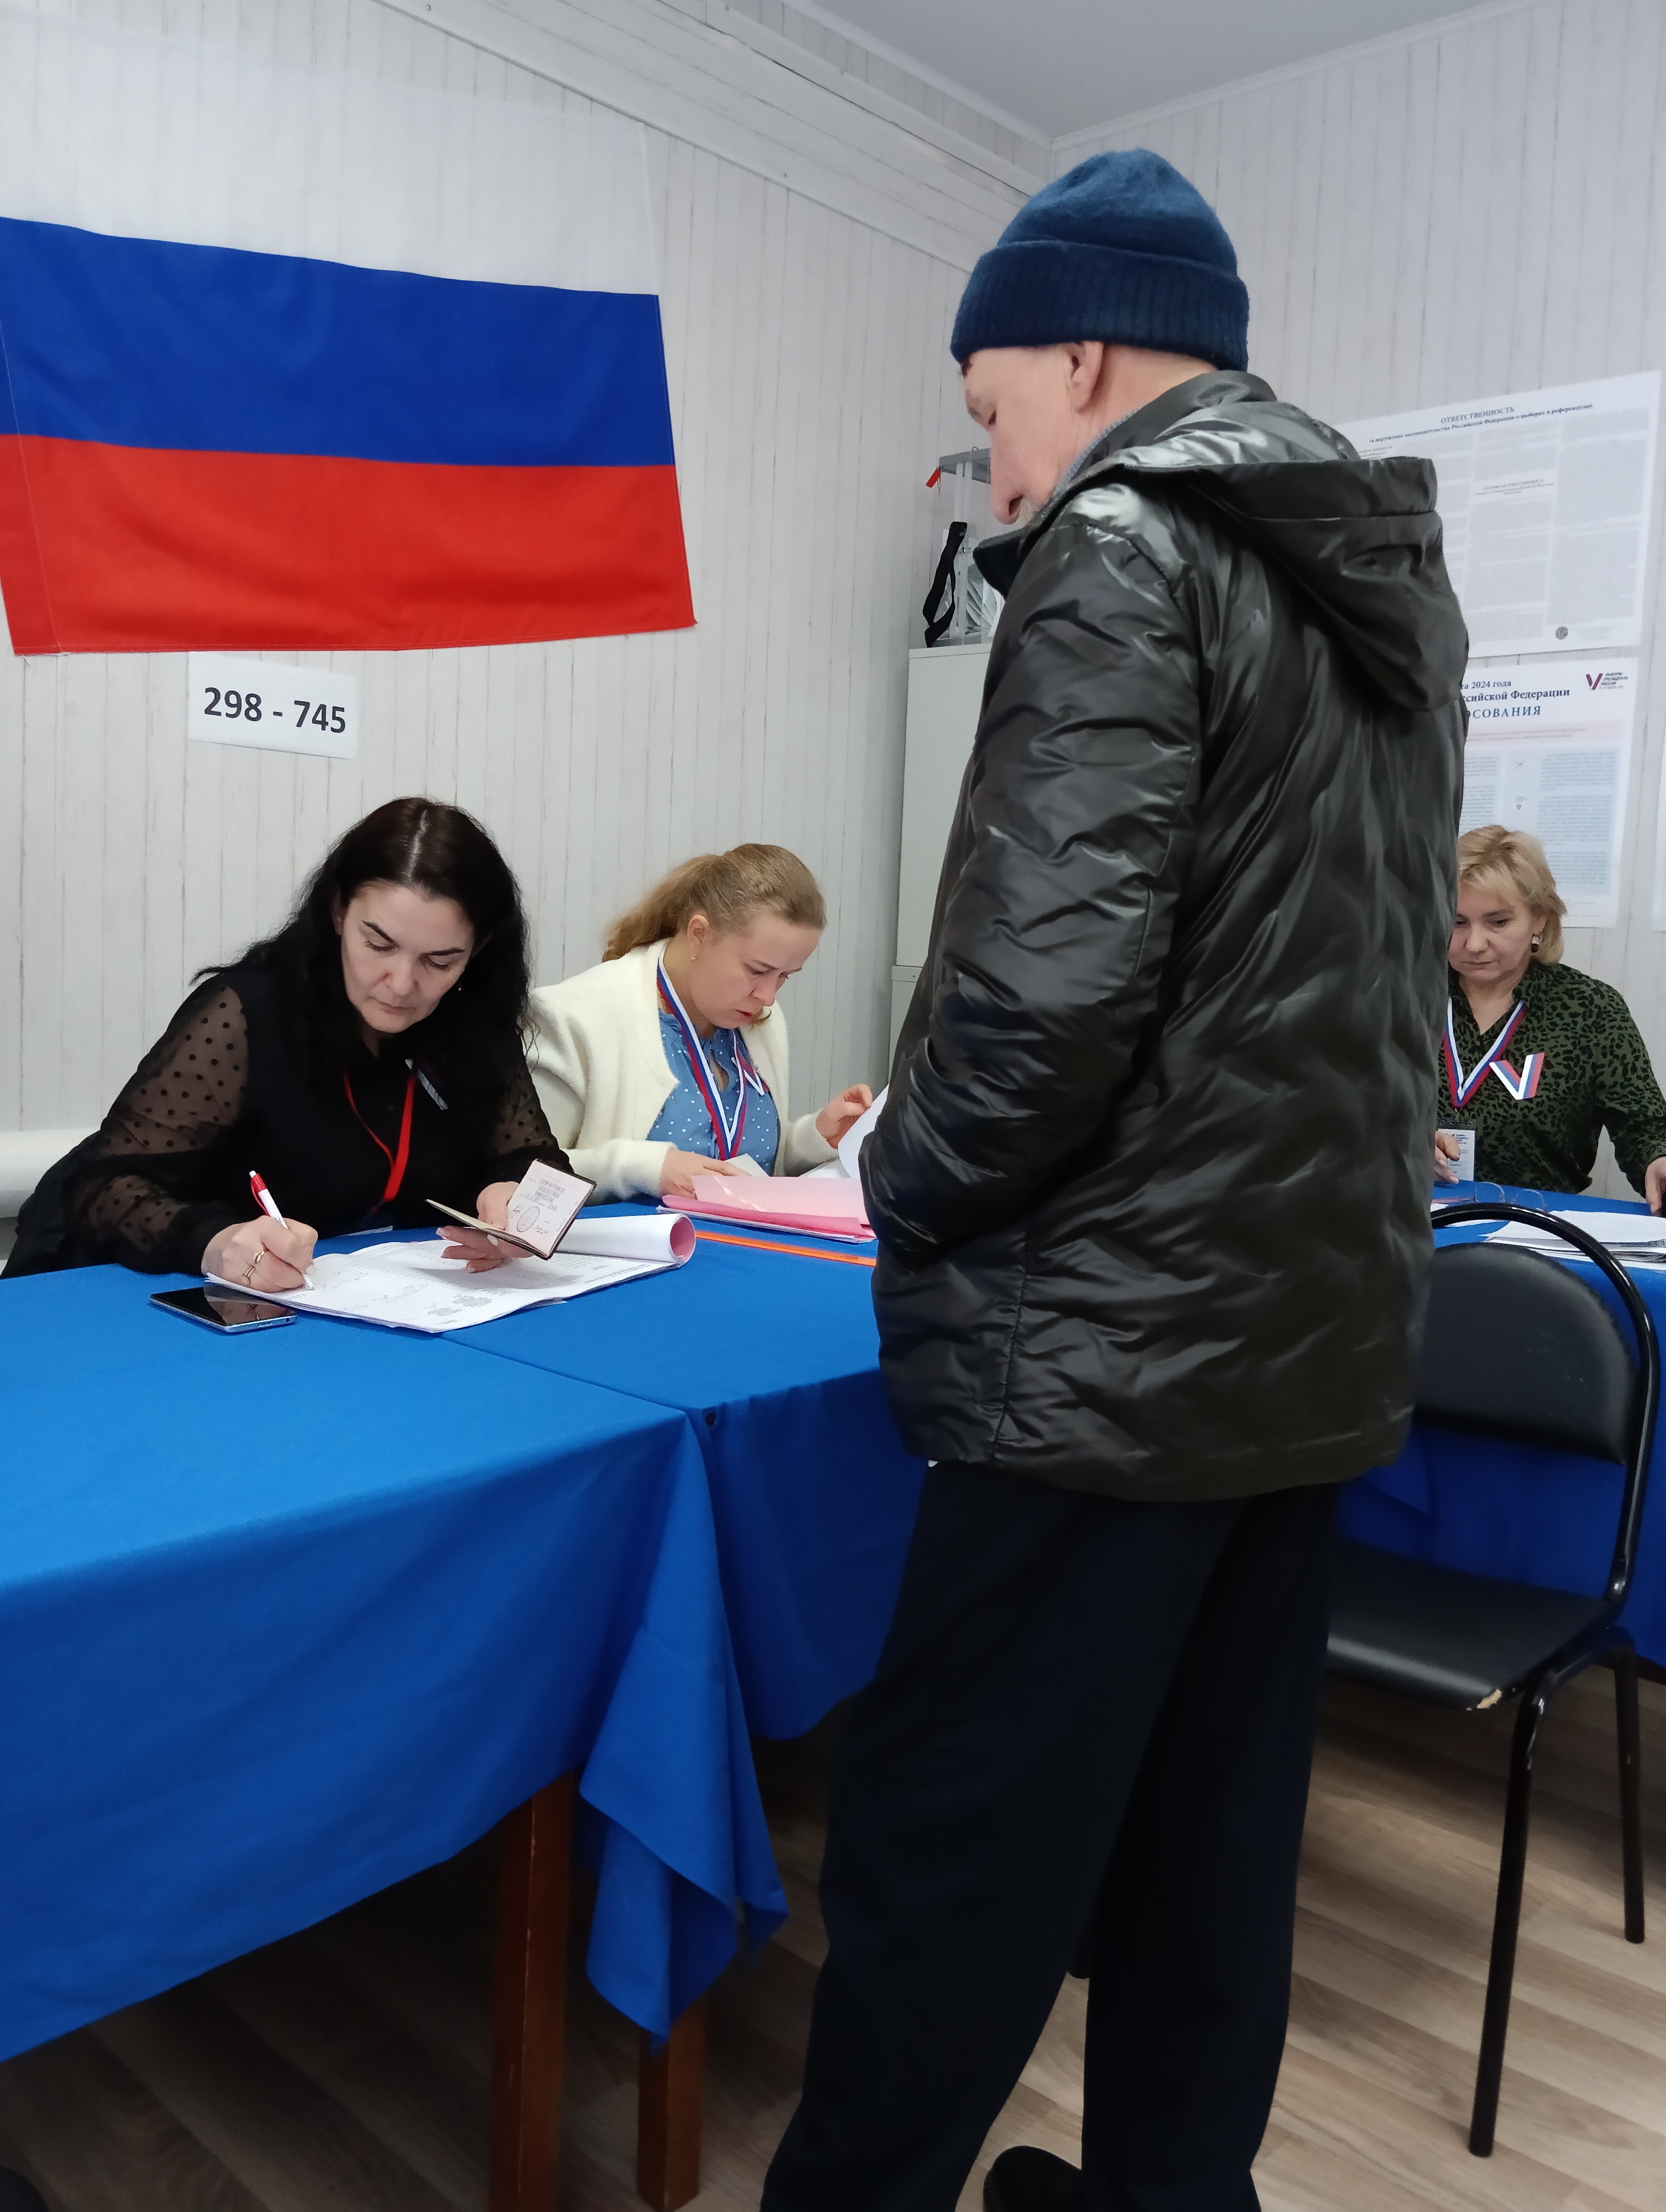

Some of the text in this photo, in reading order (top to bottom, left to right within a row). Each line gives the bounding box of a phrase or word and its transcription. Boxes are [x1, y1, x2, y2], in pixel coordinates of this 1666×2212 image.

[1441, 407, 1515, 423] ОТВЕТСТВЕННОСТЬ
[1463, 689, 1570, 702] сийской Федерации
[204, 687, 262, 722] 298
[294, 700, 346, 733] 745
